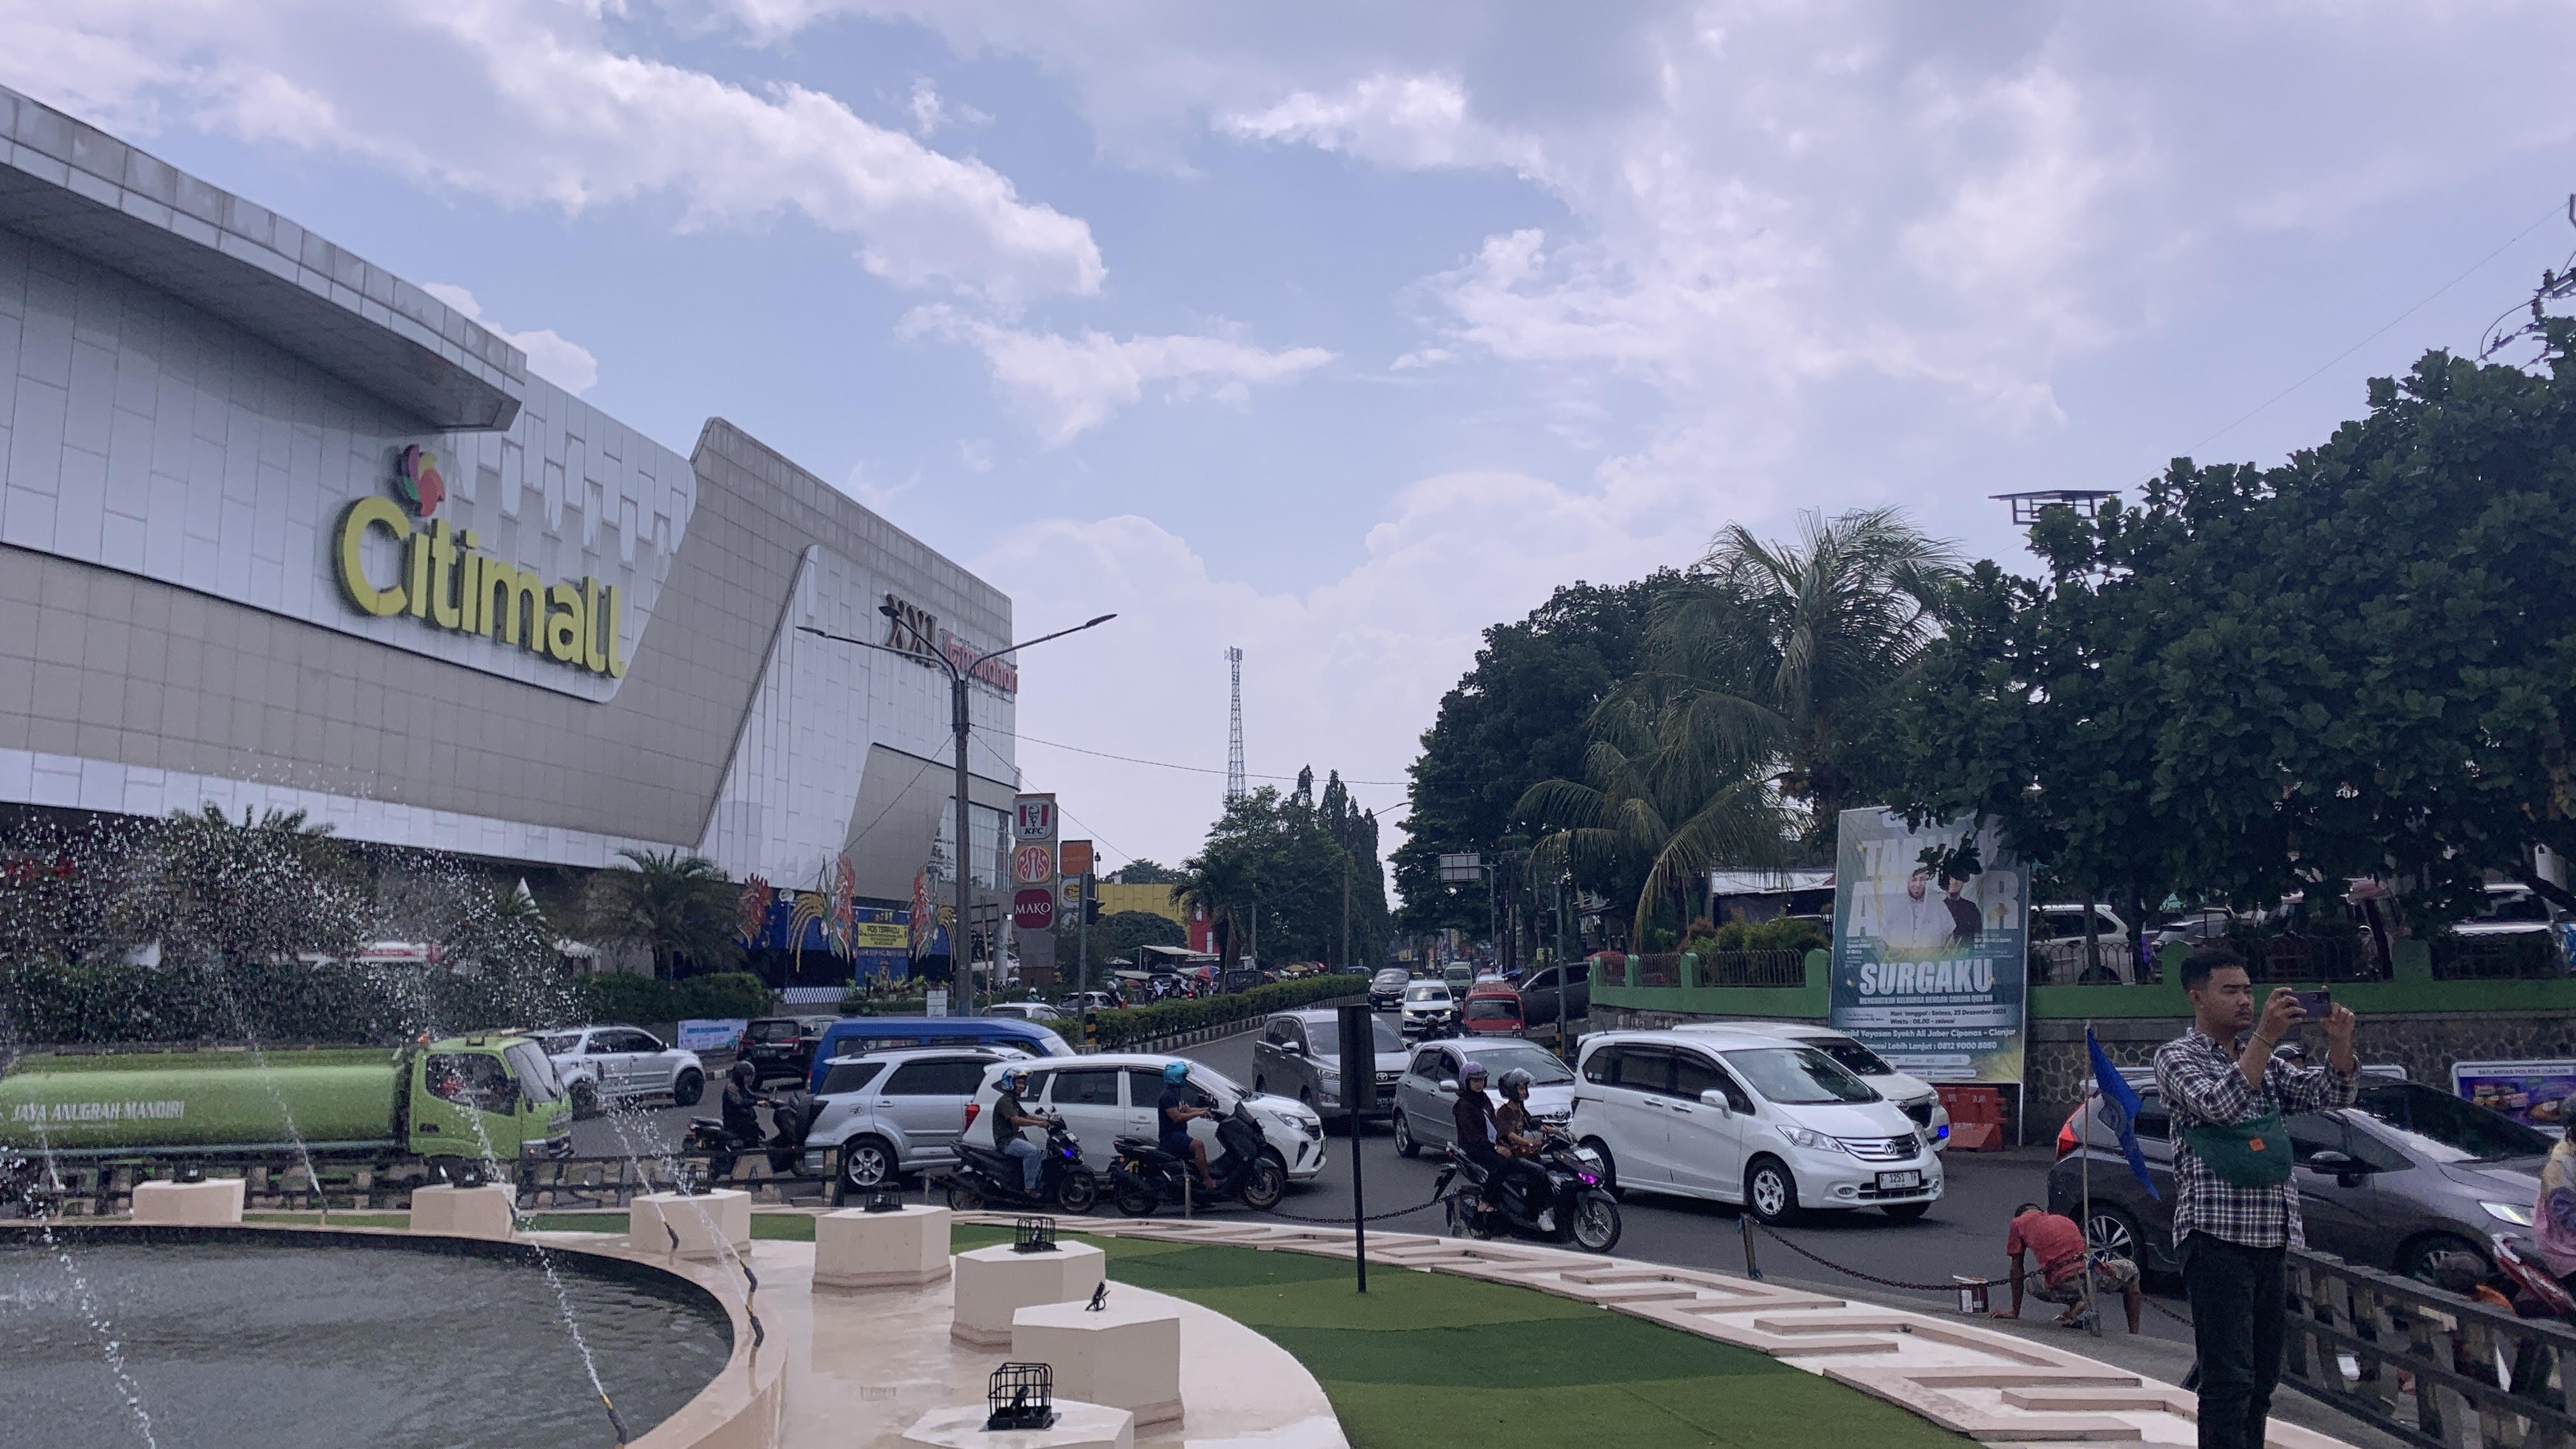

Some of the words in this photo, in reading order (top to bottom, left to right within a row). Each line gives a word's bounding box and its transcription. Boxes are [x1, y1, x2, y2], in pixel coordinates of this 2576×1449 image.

[337, 495, 627, 678] Citimall
[885, 593, 938, 668] XXI
[1015, 902, 1051, 916] MAKO
[1859, 958, 1993, 995] SURGAKU
[1860, 1030, 1891, 1038] Yayasan
[1892, 1030, 1915, 1038] Syekh
[1950, 1029, 1982, 1038] Cipanas
[1988, 1029, 2016, 1037] Cianjur
[1908, 1043, 1932, 1051] Lanjut
[11, 1103, 47, 1121] JAYA
